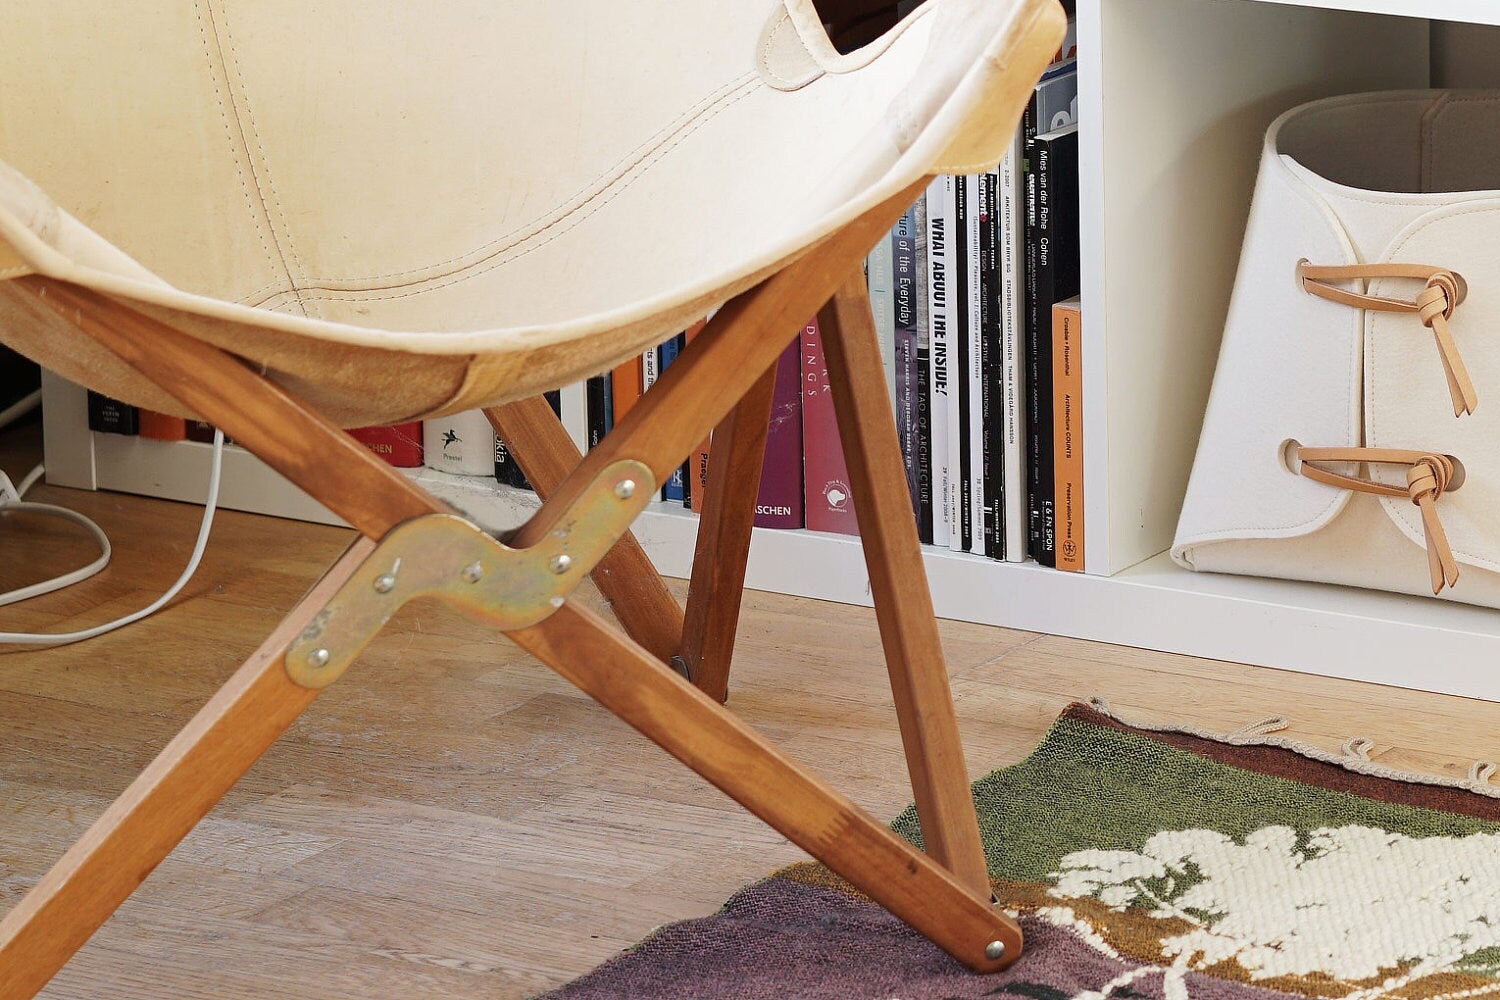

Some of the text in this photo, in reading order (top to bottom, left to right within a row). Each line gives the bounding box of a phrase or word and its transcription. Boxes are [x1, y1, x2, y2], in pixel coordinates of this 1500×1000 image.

[1039, 150, 1049, 230] Mies van der Rohe
[1040, 237, 1049, 266] Cohen
[896, 240, 911, 325] of the Everyday
[443, 453, 463, 463] Prestel
[918, 369, 929, 504] THE TAO OF ARCHITECTURE
[1046, 516, 1053, 527] FN
